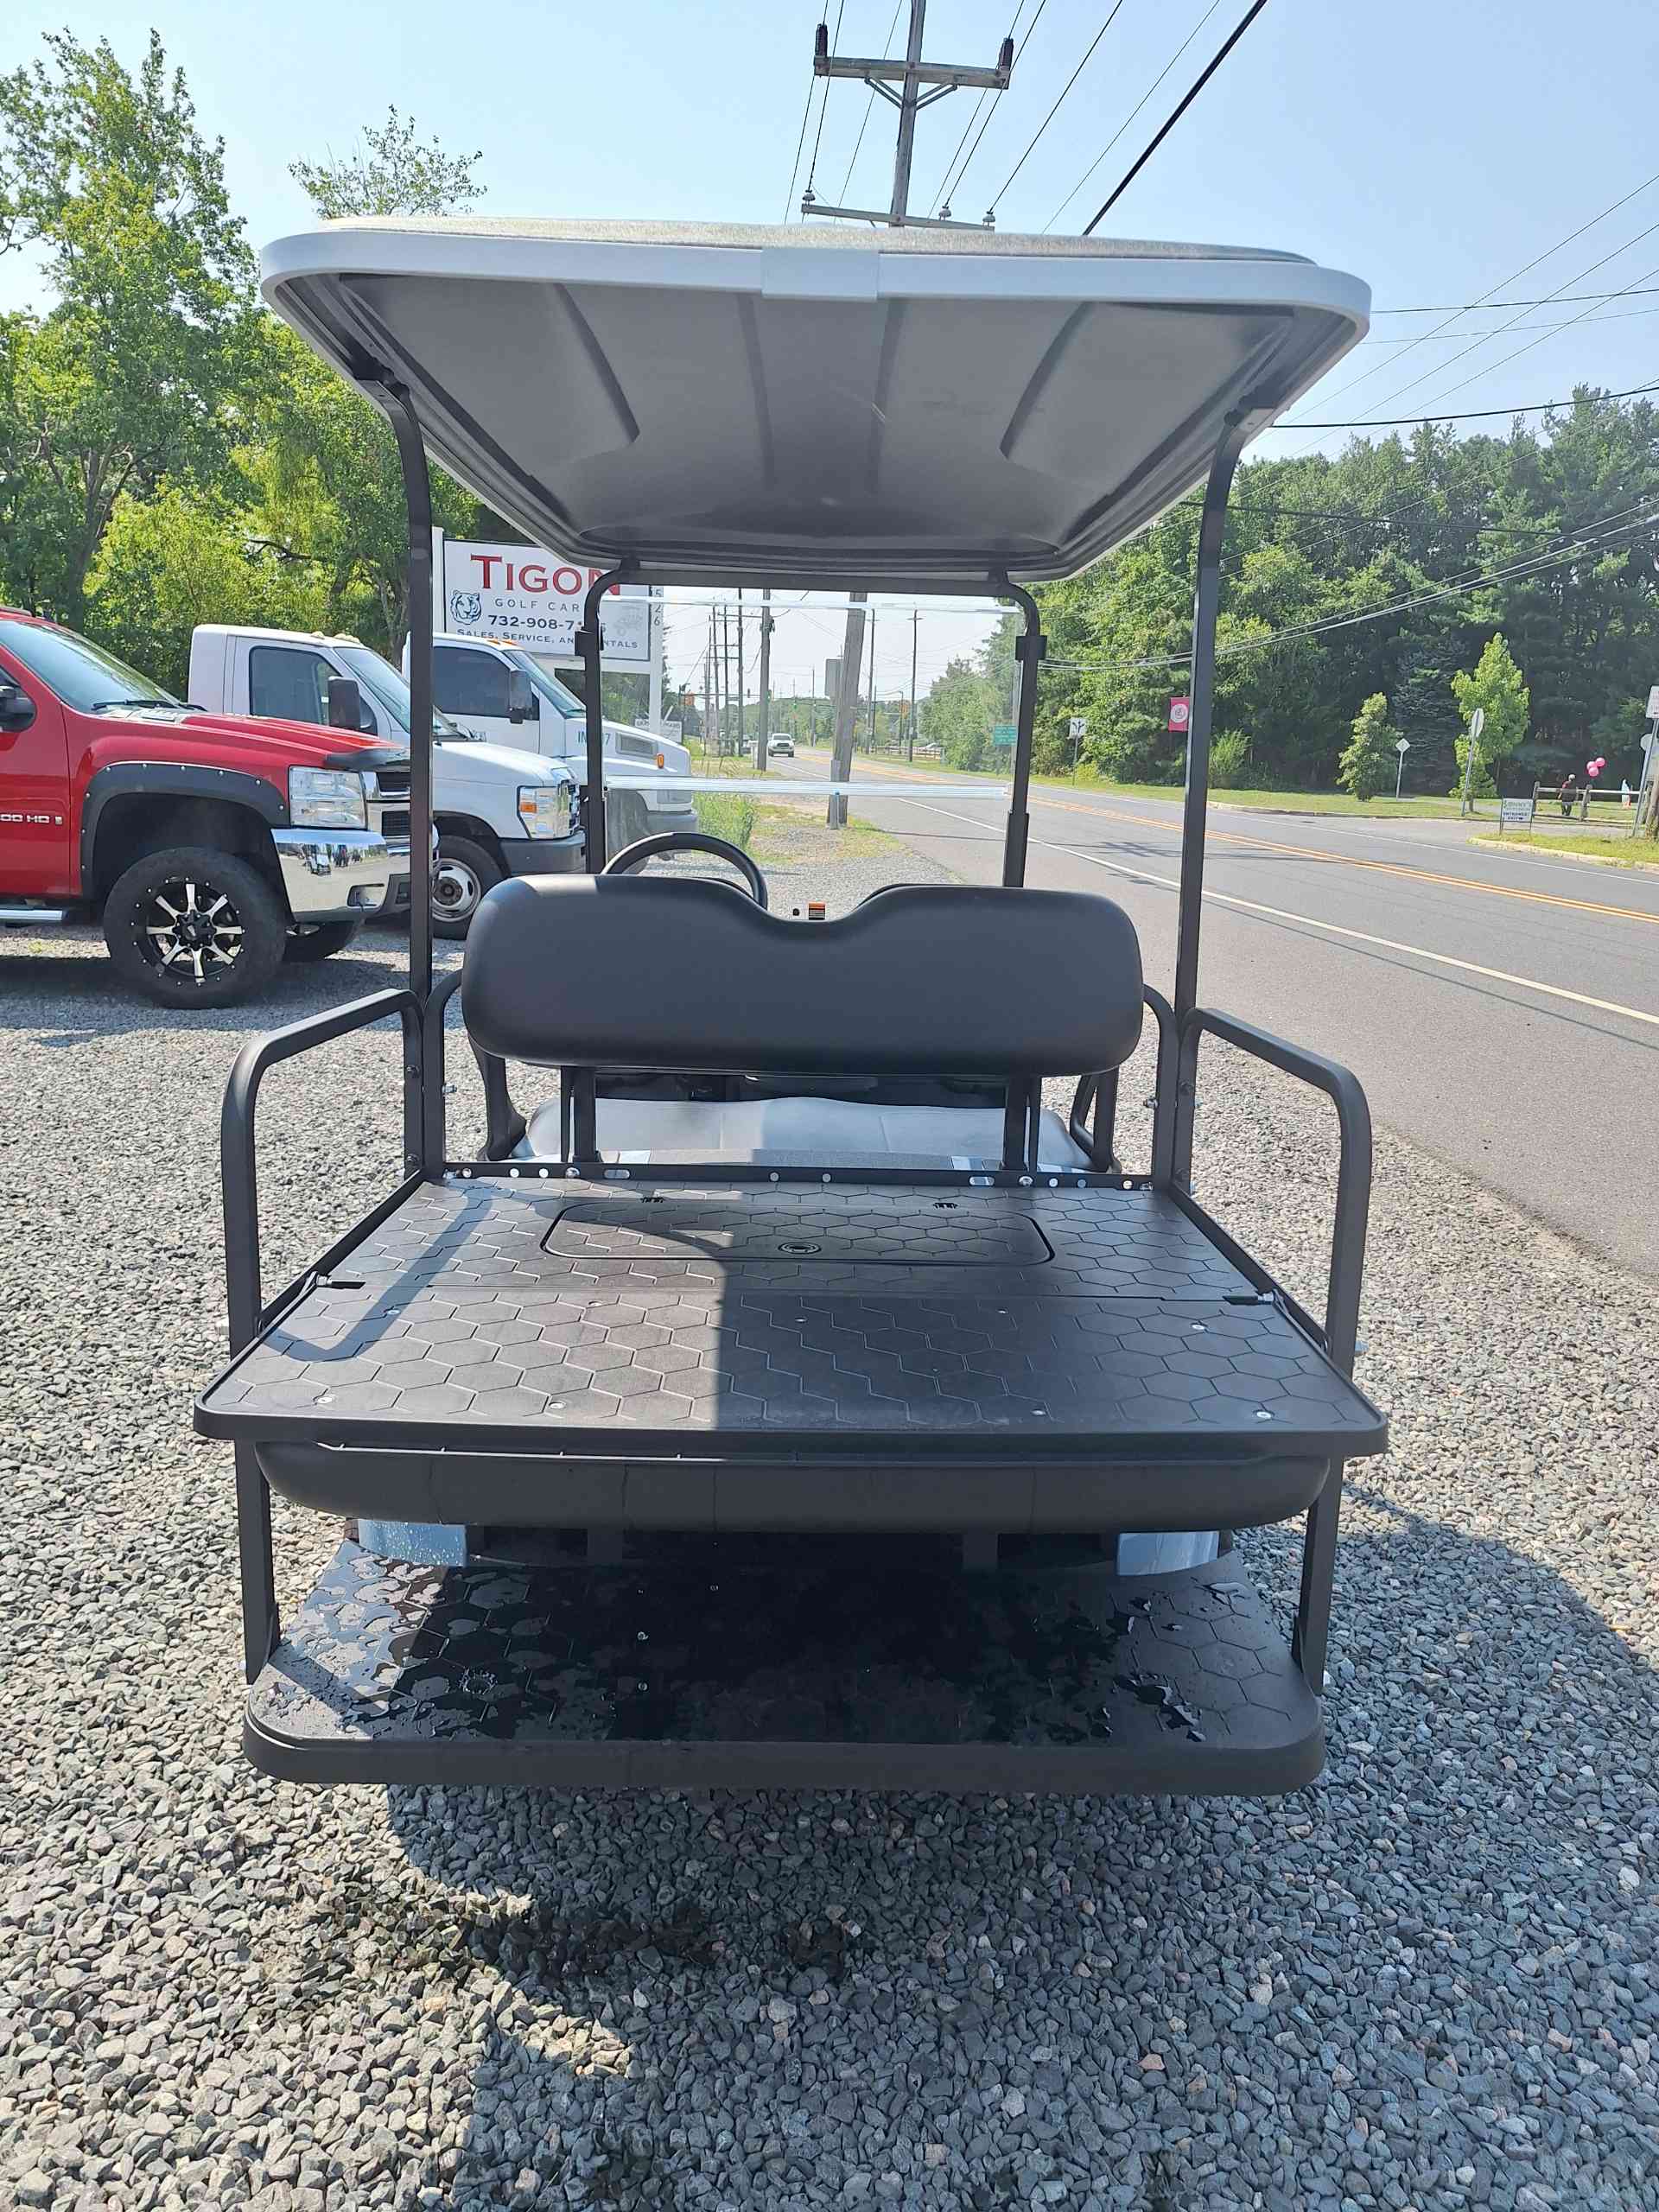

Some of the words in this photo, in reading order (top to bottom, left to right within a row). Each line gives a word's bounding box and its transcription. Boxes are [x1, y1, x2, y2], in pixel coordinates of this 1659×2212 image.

[494, 598, 538, 609] GOLF
[548, 601, 580, 613] CAR
[488, 614, 606, 633] 732-908-7
[27, 815, 49, 823] HD
